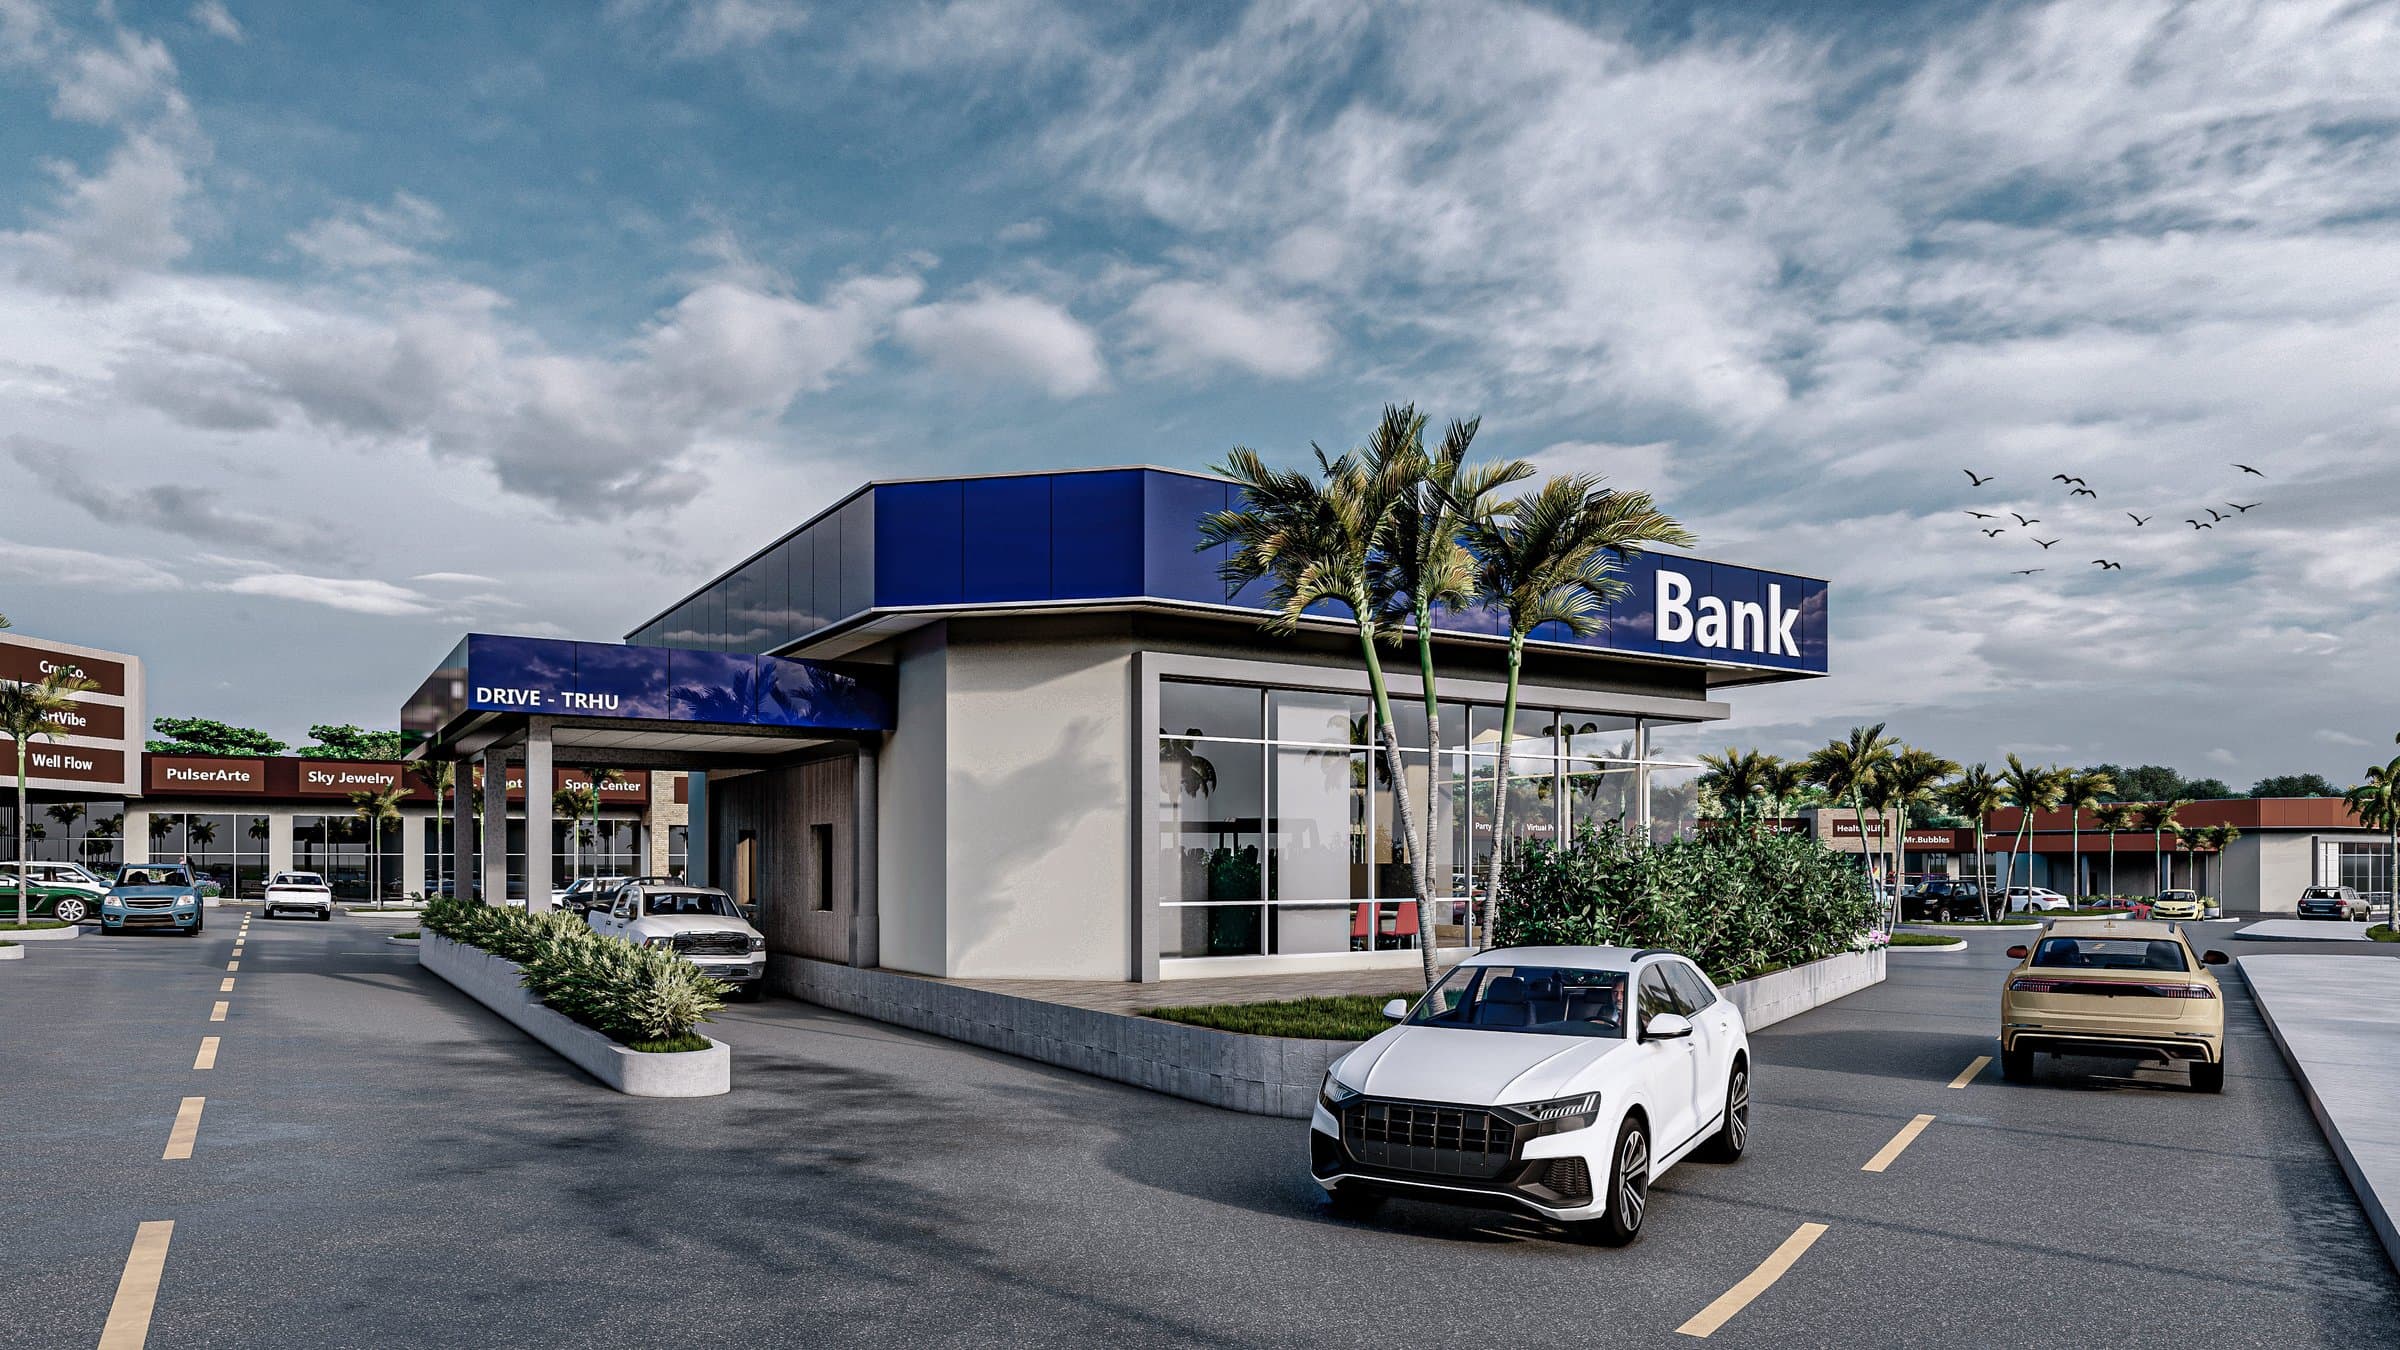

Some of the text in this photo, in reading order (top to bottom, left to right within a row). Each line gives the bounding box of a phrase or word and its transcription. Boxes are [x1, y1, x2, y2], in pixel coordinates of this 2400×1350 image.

[1655, 569, 1801, 658] Bank
[476, 687, 541, 706] DRIVE
[561, 691, 619, 710] TRHU
[40, 710, 87, 727] ArtVibe
[31, 753, 93, 771] Well Flow
[166, 767, 250, 782] PulserArte
[308, 771, 395, 787] Sky Jewelry
[1526, 823, 1547, 832] Virtual
